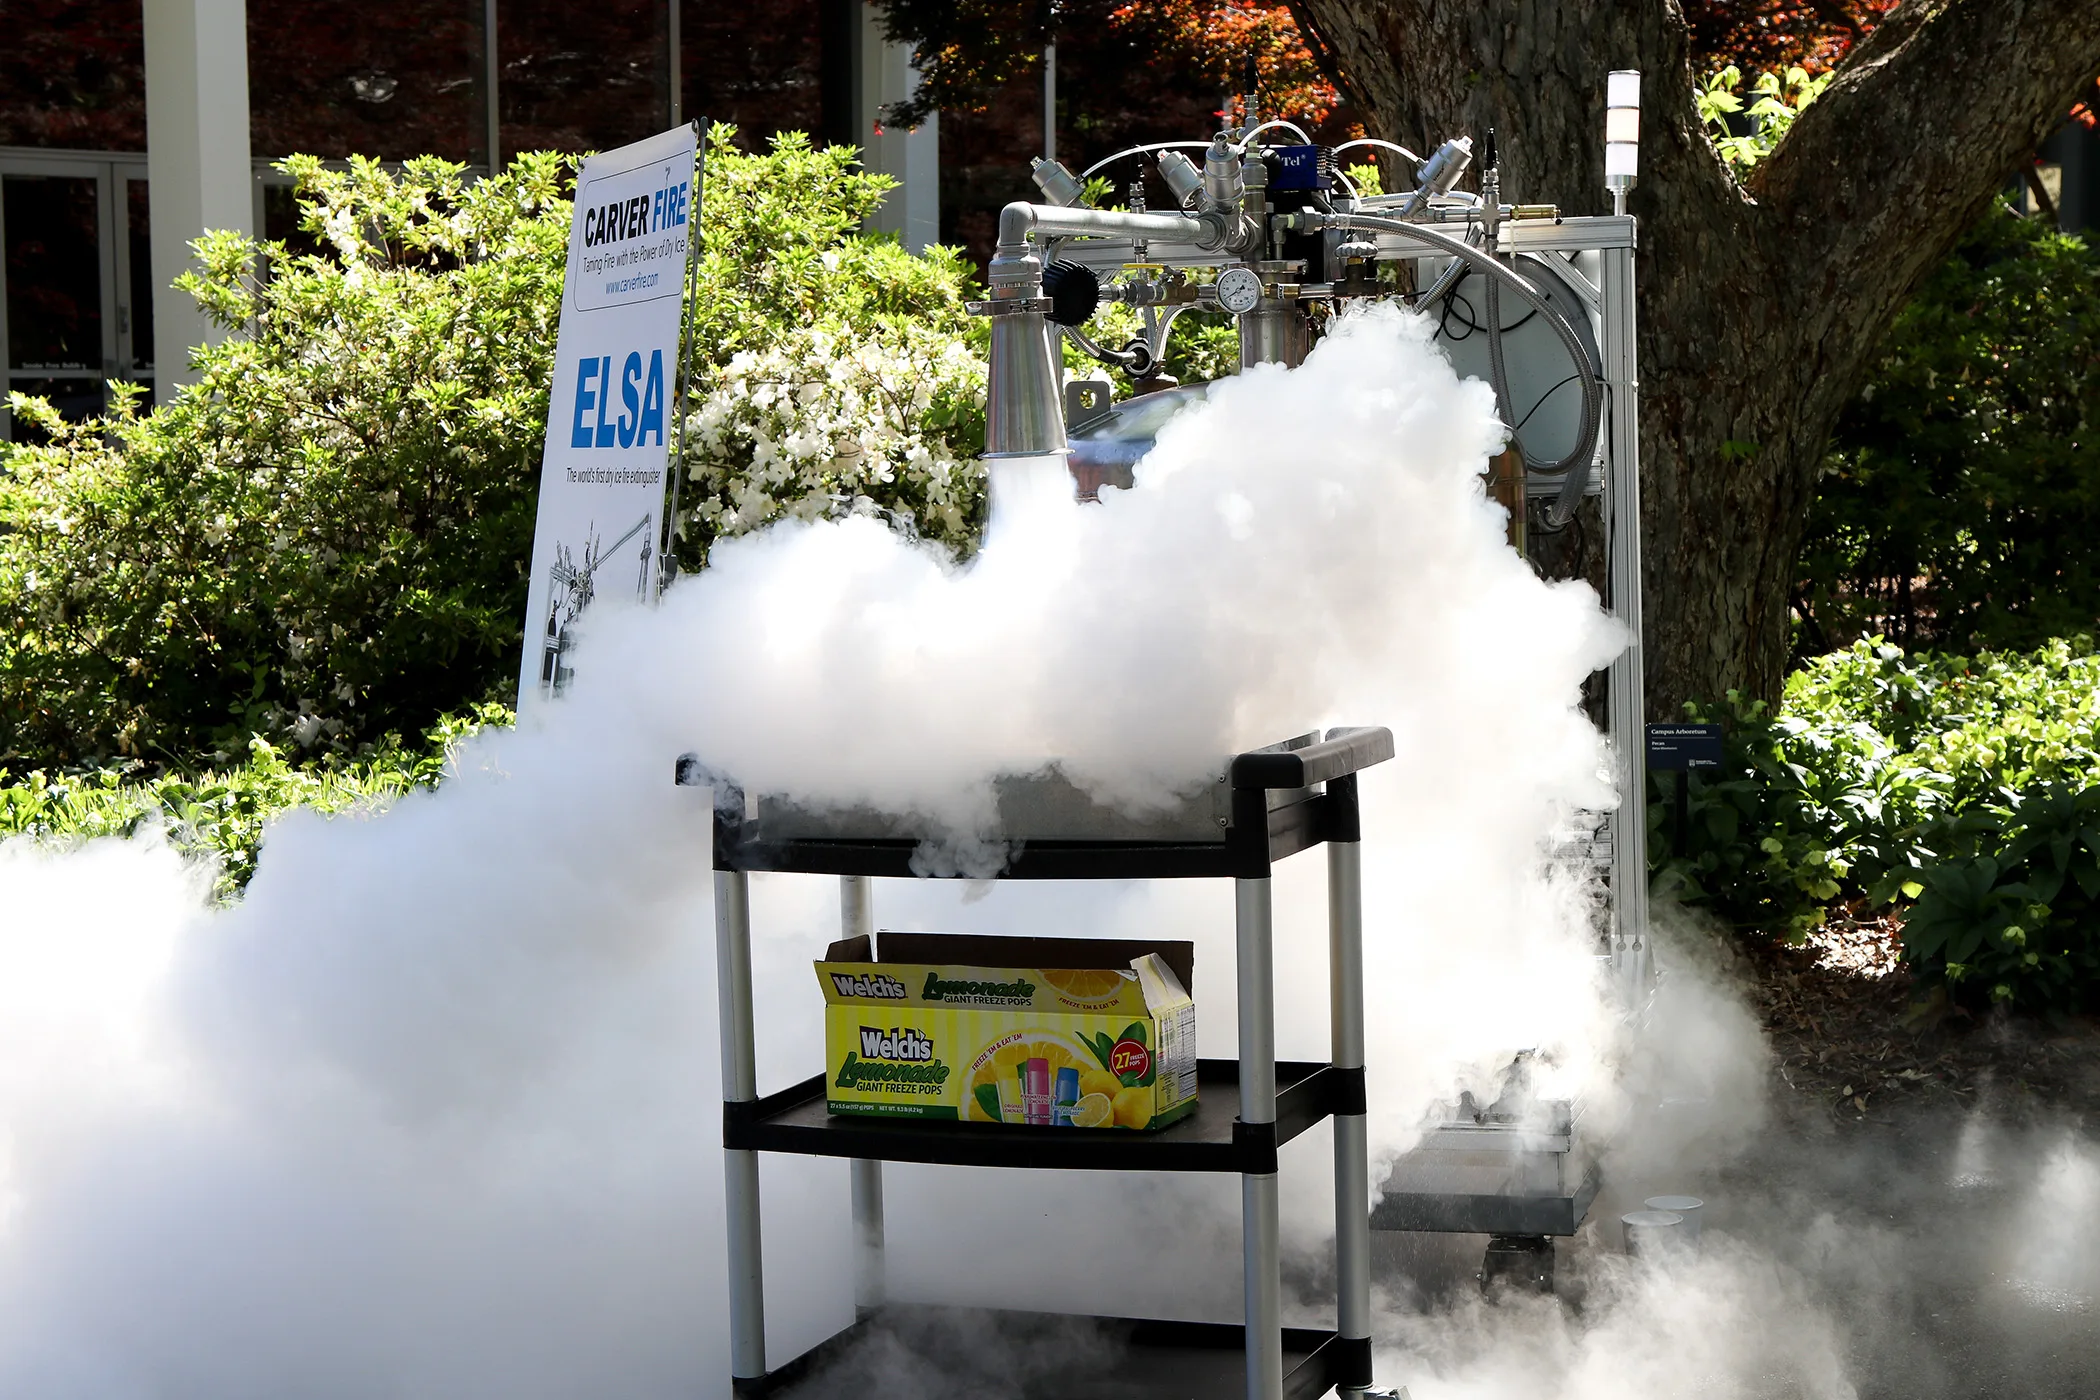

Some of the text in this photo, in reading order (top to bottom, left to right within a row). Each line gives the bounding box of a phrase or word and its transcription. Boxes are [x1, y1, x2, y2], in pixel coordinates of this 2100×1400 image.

[585, 181, 687, 248] CARVER FIRE
[583, 236, 686, 275] Taming Fire with the Power of Dry Ice
[605, 272, 659, 295] www.carverfire.com
[570, 349, 664, 449] ELSA
[566, 467, 577, 483] The
[578, 467, 595, 483] world's
[595, 467, 606, 484] first
[606, 467, 614, 487] dry
[614, 467, 622, 484] ice
[630, 467, 661, 488] extinguisher
[832, 972, 1036, 1000] Welch's Lemonade
[944, 995, 1032, 1006] GIANT FREEZE POPS
[1058, 997, 1080, 1008] FREEZE
[860, 1028, 932, 1060] Welch's
[971, 1052, 988, 1071] FREEZE
[1001, 1036, 1012, 1046] EAT
[1011, 1033, 1023, 1041] 'EM
[835, 1051, 950, 1088] Lemonade
[1115, 1052, 1130, 1069] 27
[856, 1081, 943, 1095] GIANT FREEZE POPS
